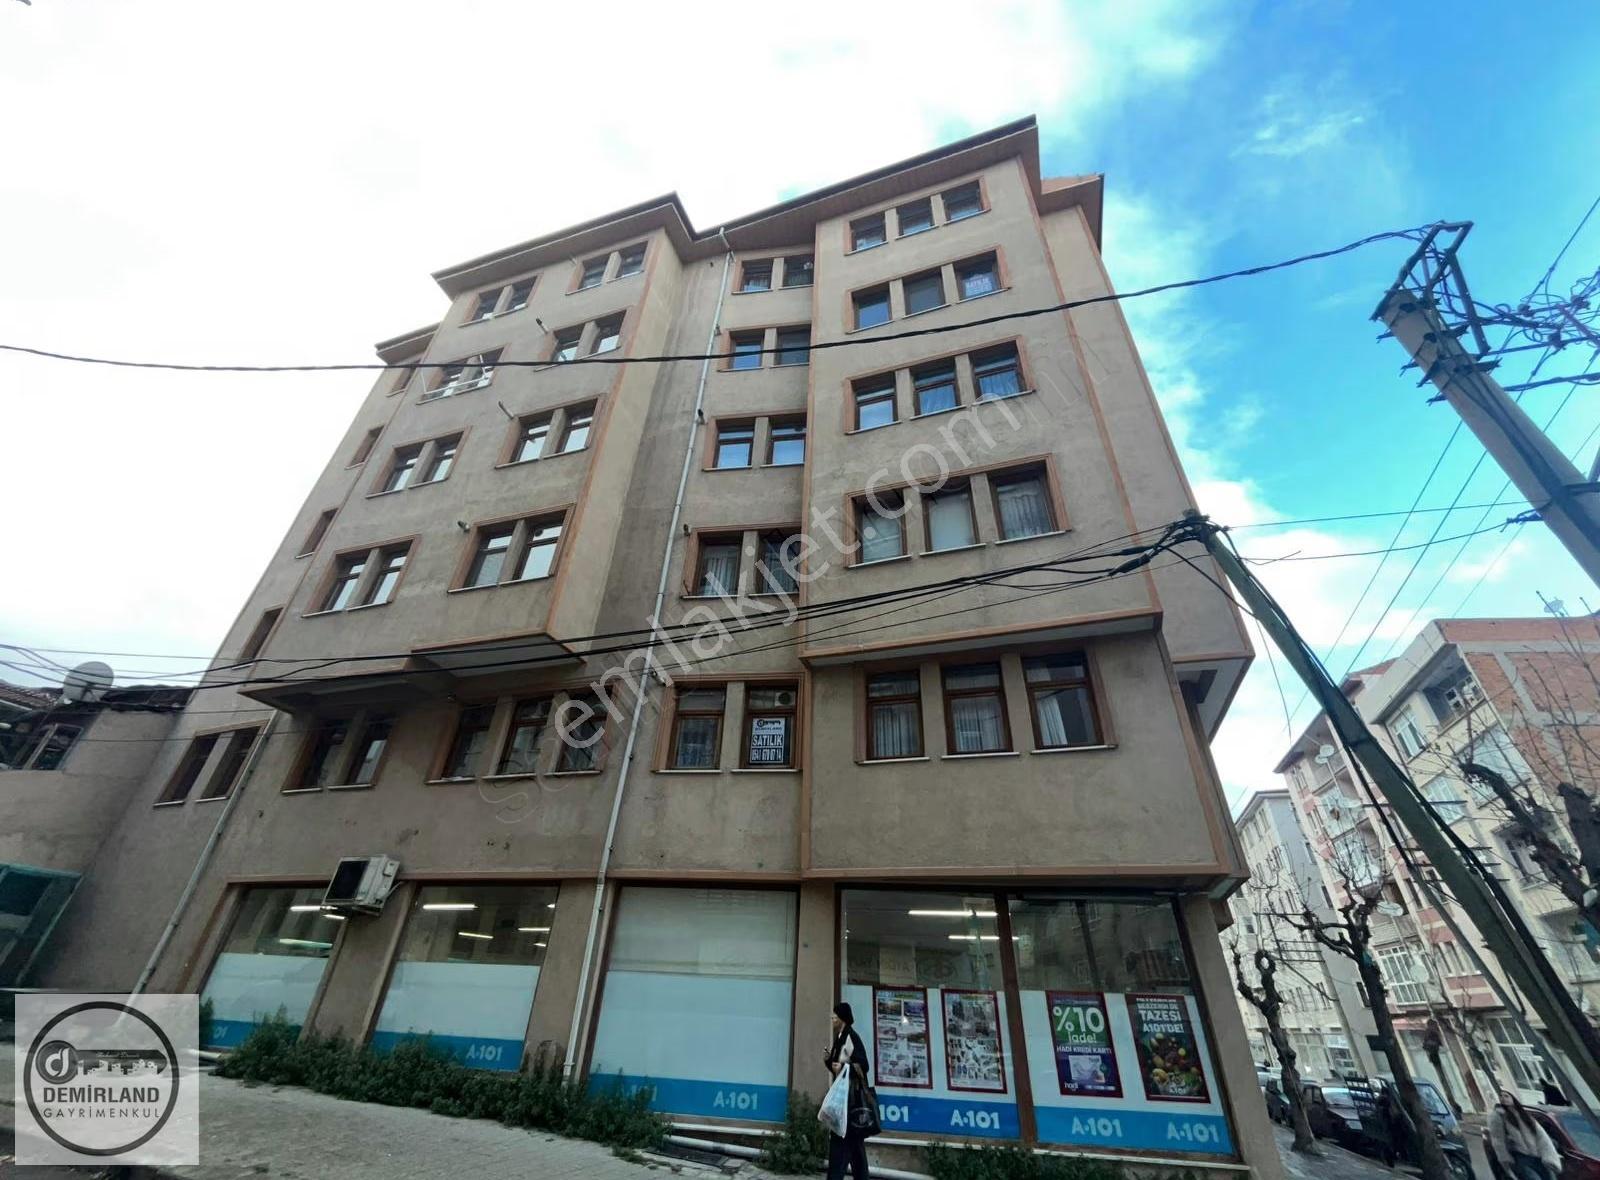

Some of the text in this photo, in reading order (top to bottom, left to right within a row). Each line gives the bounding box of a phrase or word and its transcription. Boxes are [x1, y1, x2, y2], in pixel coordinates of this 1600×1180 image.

[752, 735, 783, 746] SATILIK
[1053, 1006, 1105, 1034] %10
[879, 1104, 909, 1123] 101
